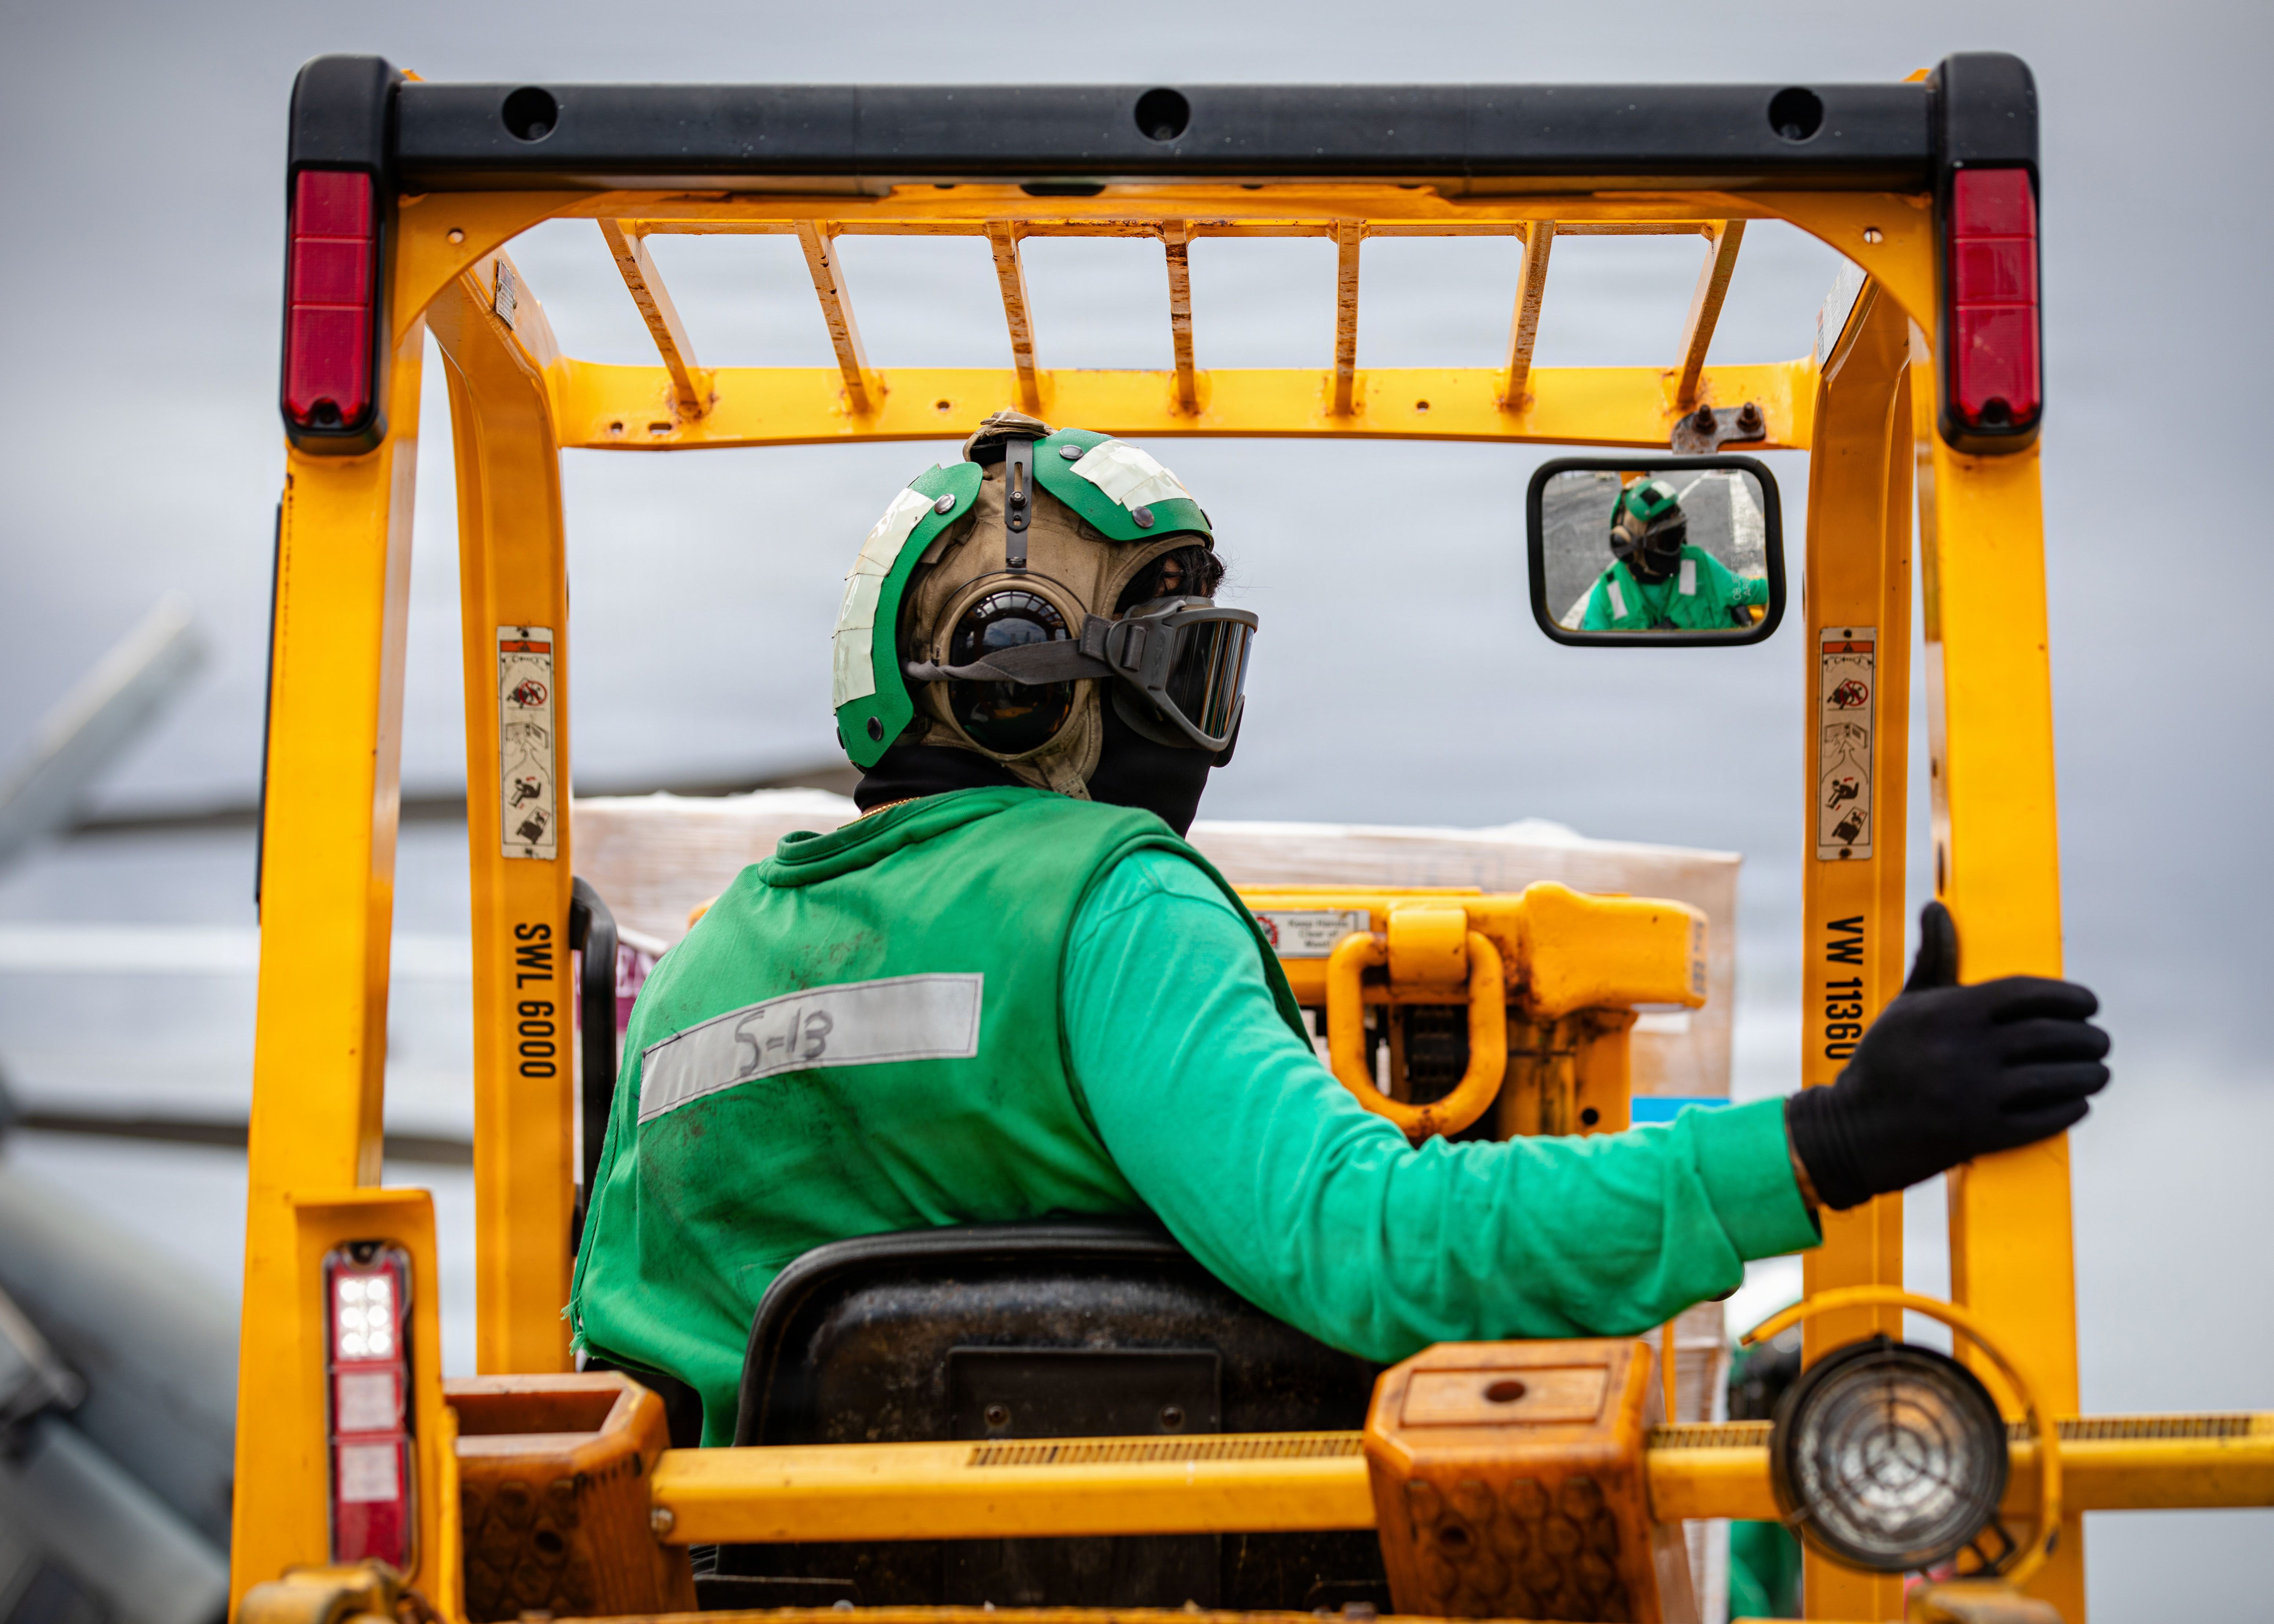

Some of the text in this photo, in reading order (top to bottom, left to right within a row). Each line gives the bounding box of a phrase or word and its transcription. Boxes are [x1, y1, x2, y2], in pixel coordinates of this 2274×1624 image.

[1731, 555, 1741, 600] OBJETS
[514, 923, 556, 1078] SWL 6000
[1825, 916, 1864, 1060] VW 11360
